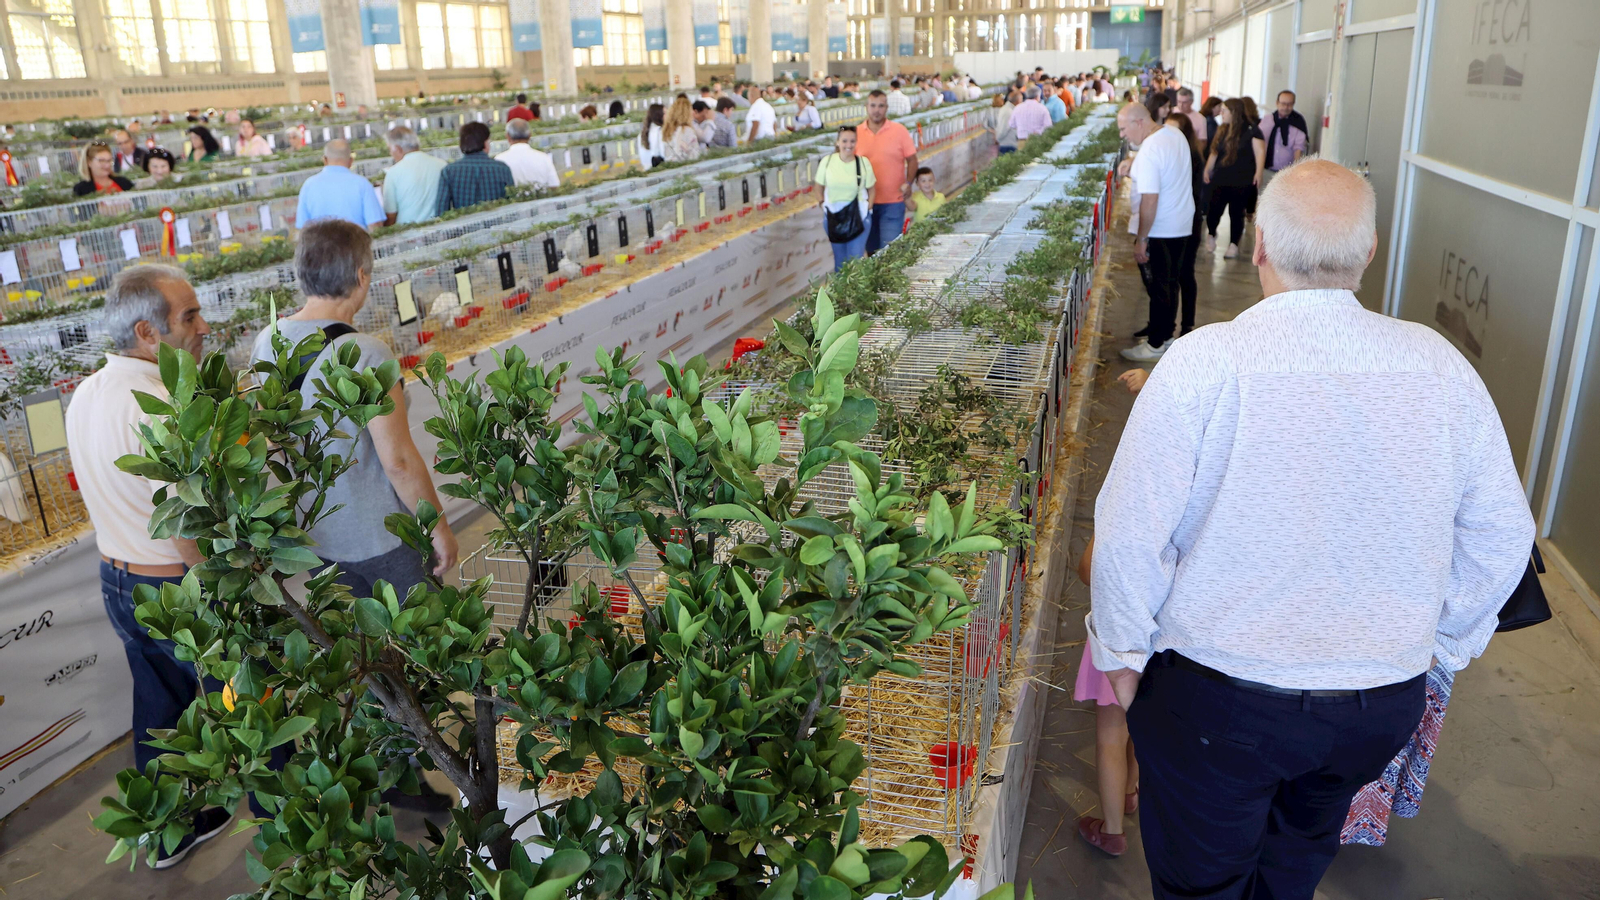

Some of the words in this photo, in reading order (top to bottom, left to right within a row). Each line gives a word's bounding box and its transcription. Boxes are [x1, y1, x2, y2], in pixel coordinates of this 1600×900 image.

[1471, 0, 1530, 45] IFECA
[1439, 249, 1489, 320] IFECA
[45, 654, 97, 686] CAMPER
